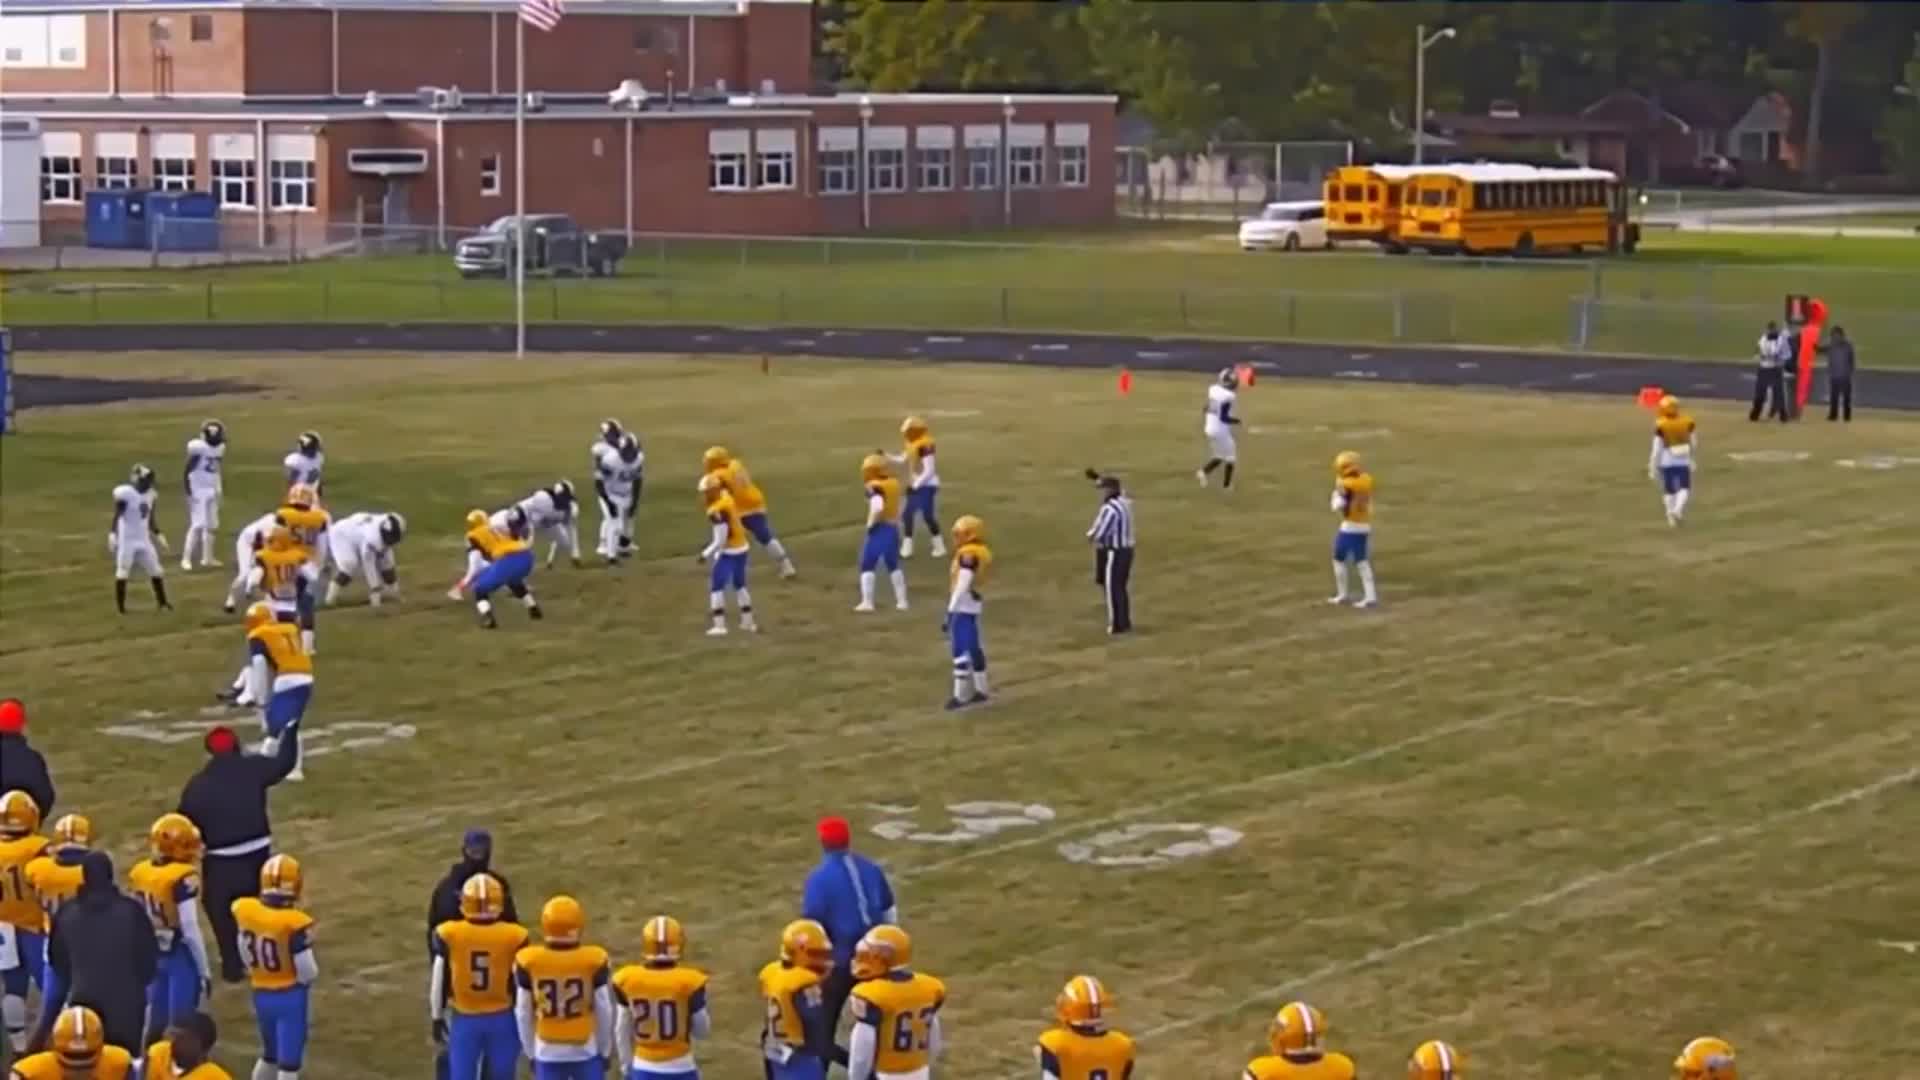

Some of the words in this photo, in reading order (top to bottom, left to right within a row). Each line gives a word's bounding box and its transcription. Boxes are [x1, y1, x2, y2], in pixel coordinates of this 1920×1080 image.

[242, 929, 281, 973] 30
[470, 951, 490, 992] 5
[537, 977, 584, 1019] 32
[631, 997, 678, 1041] 20
[893, 1006, 936, 1052] 63
